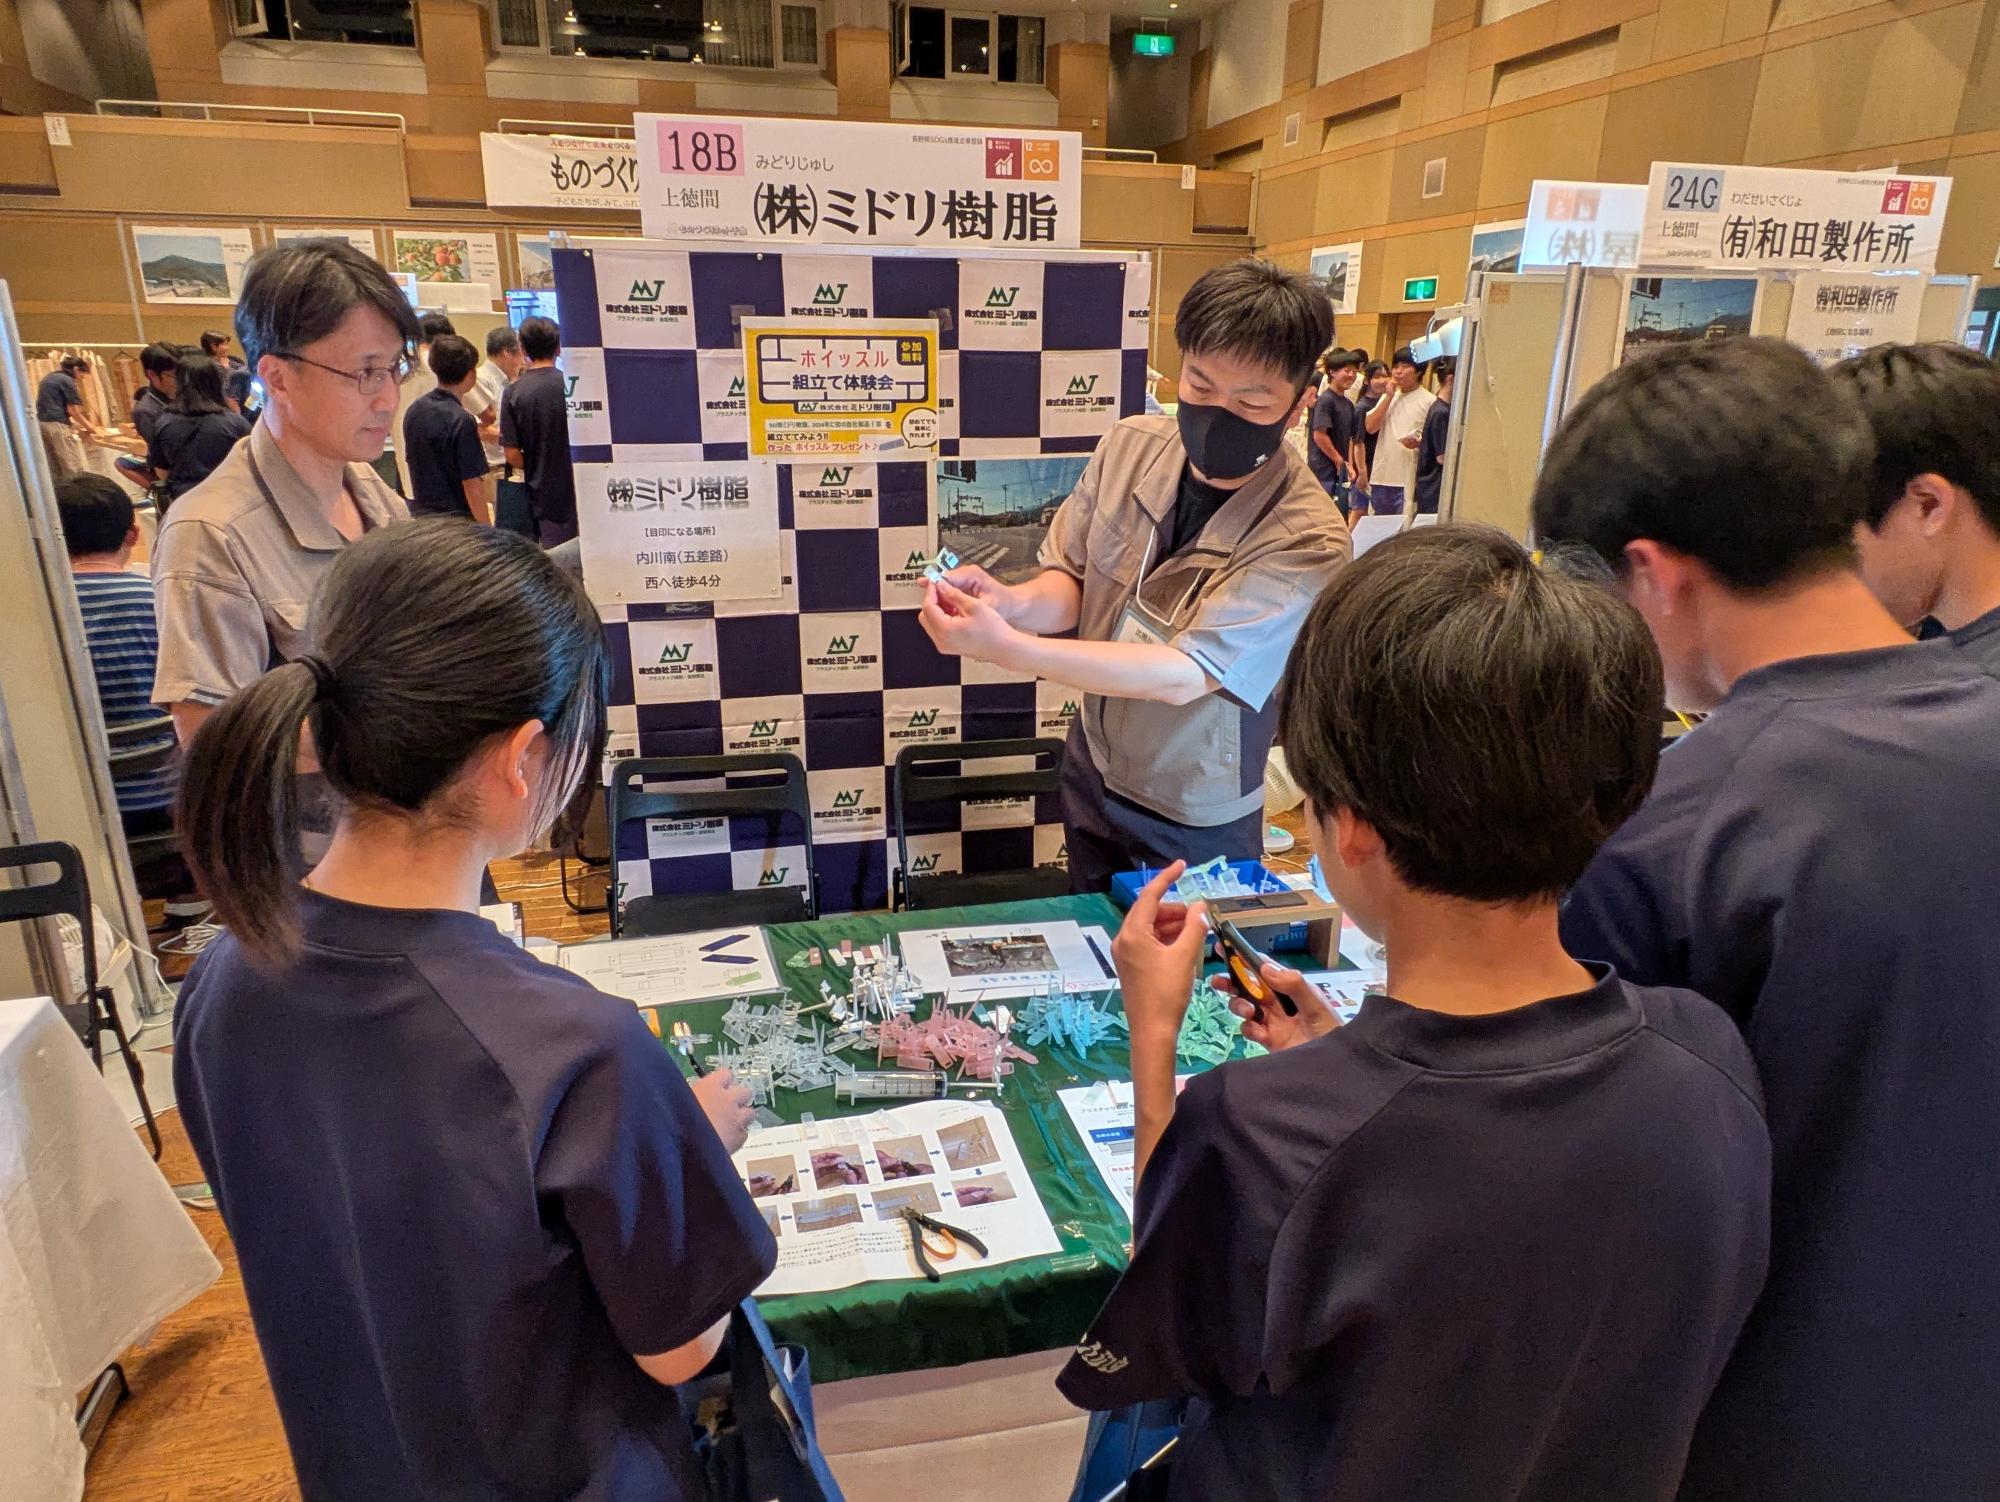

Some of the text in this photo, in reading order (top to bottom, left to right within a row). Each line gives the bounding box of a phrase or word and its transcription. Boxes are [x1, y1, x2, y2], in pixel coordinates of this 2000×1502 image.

[668, 130, 737, 172] 18B
[756, 154, 835, 172] みどりじゅし
[661, 187, 720, 209] 上徳間
[1667, 175, 1719, 209] 24G
[1731, 192, 1803, 208] わだせいさくじょ
[753, 181, 1058, 242] (株)ミドリ樹脂
[1658, 220, 1700, 239] 上徳間
[1720, 214, 1916, 264] (有)和田製作所
[801, 350, 889, 368] ホイッスル
[792, 374, 895, 392] 組立て体験会
[636, 549, 729, 565] 内川南(五差路)
[645, 574, 721, 589] 西へ徒歩4分
